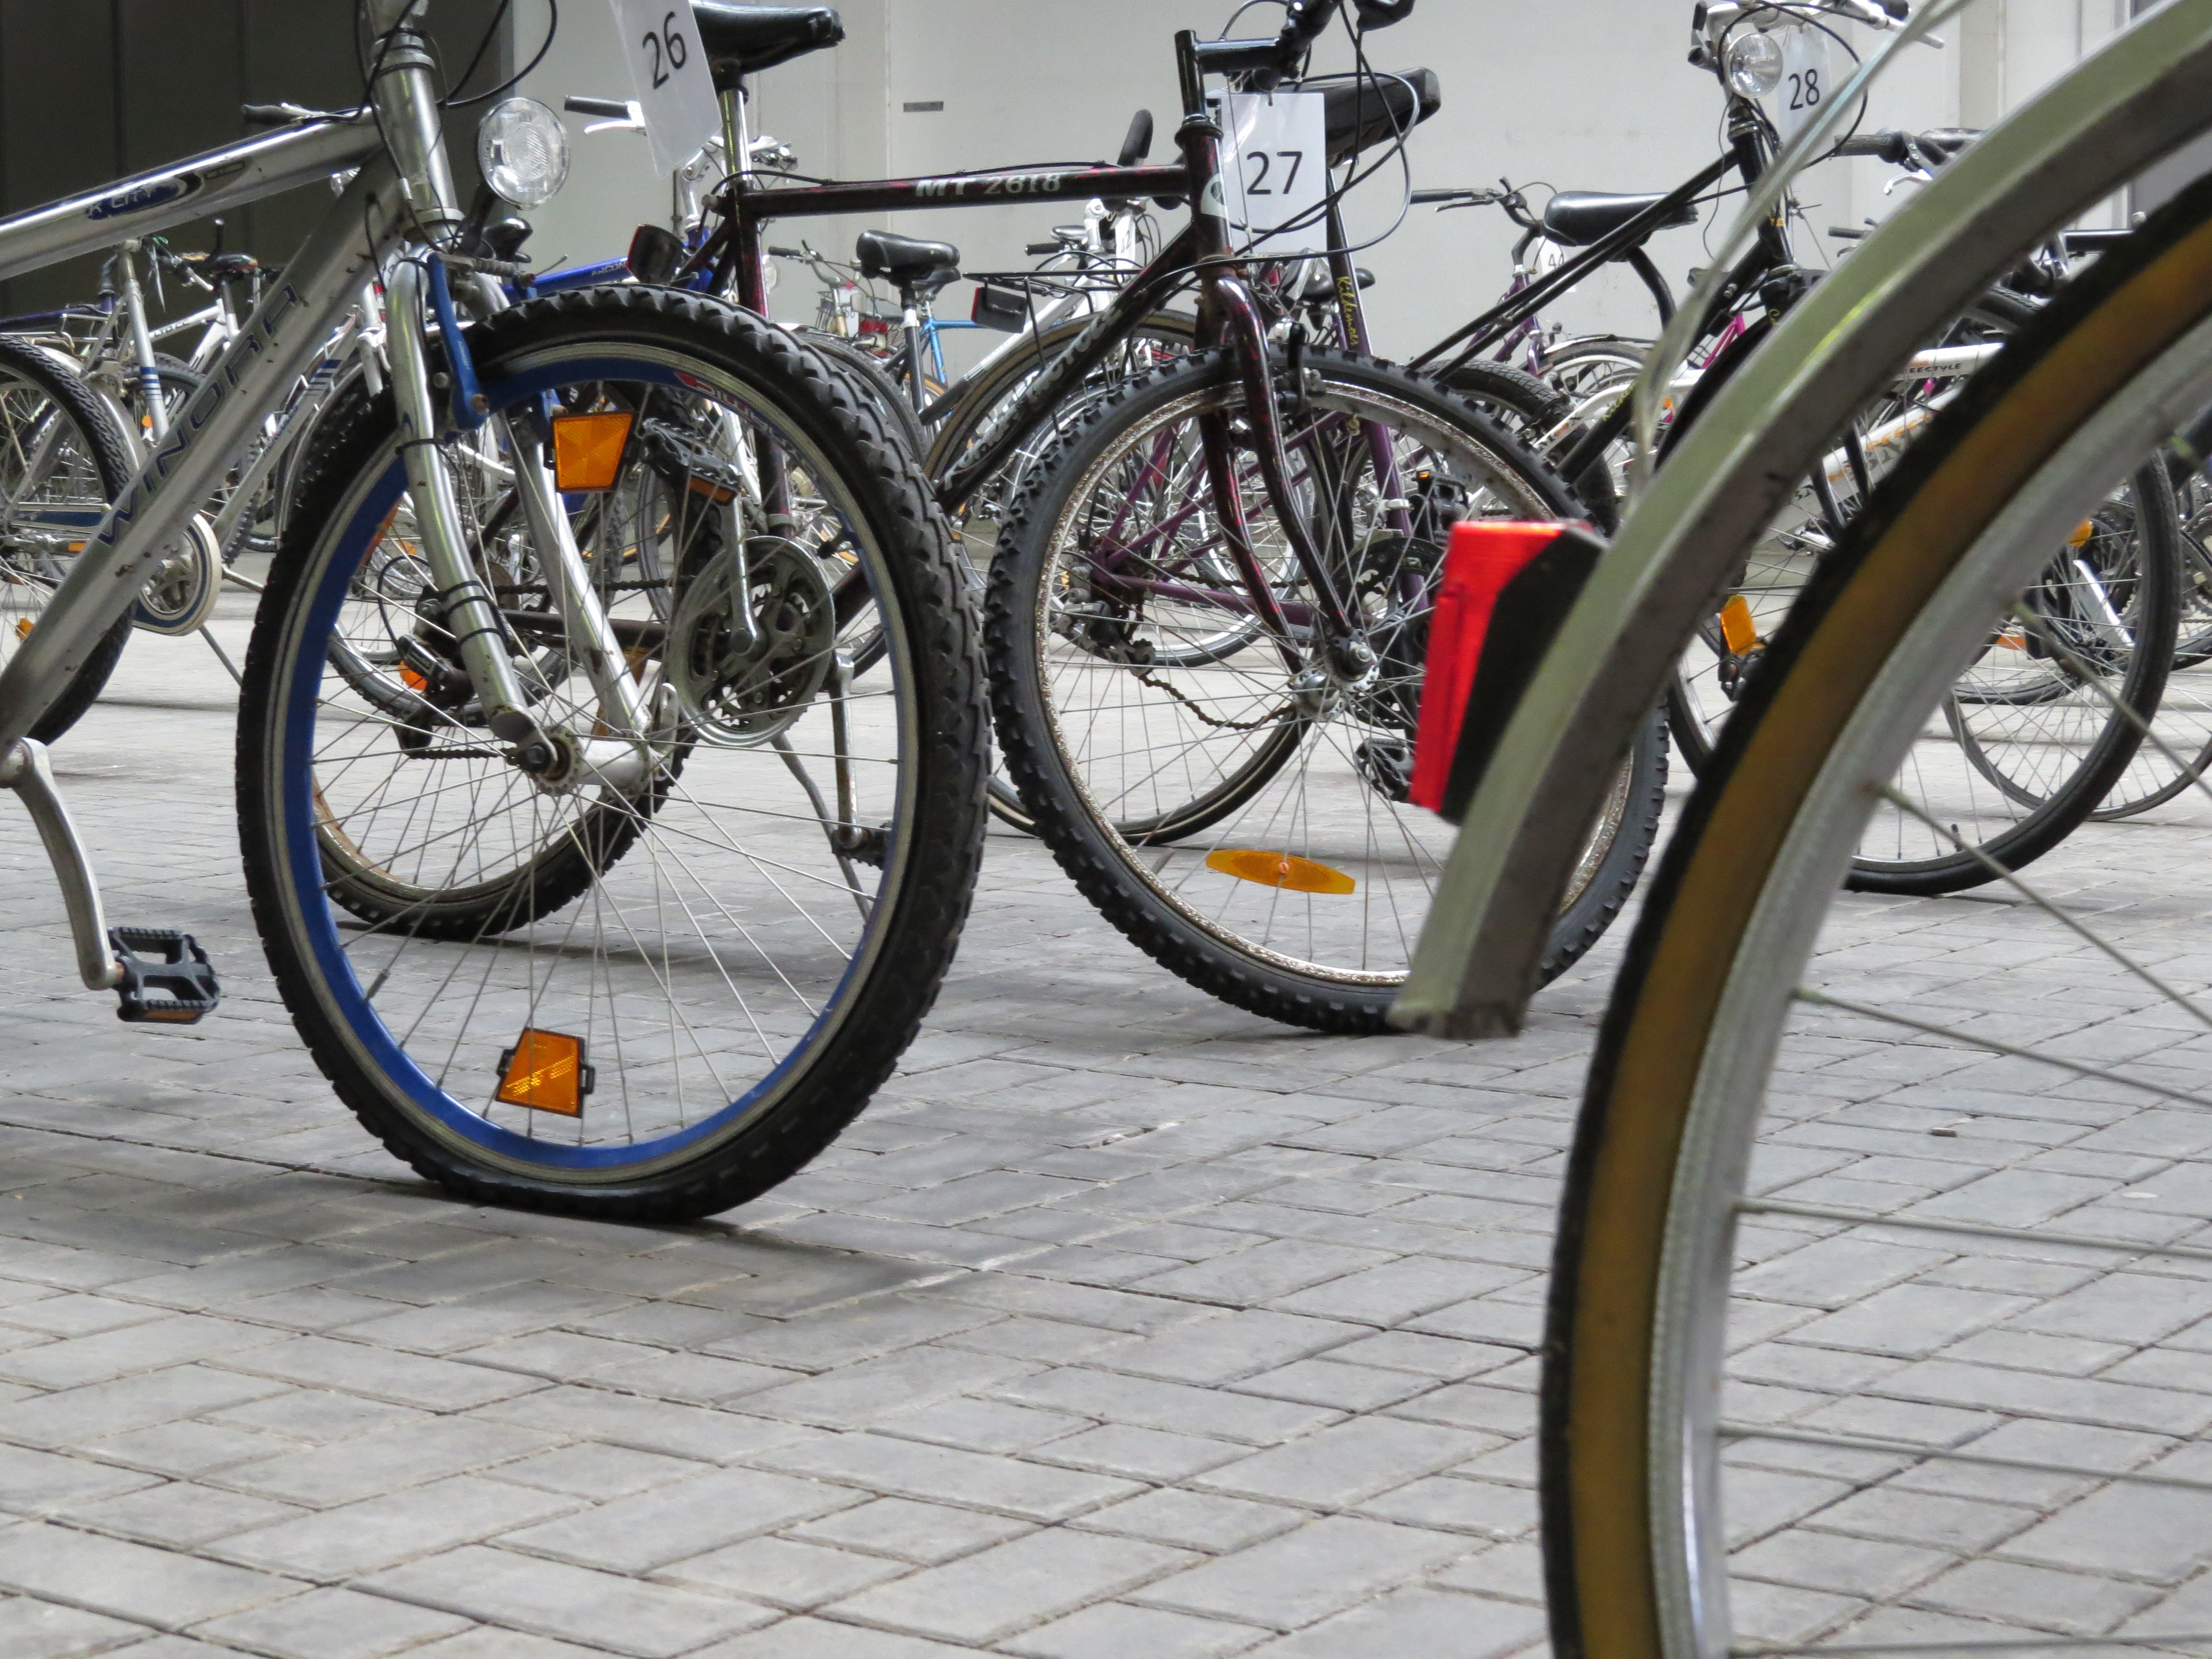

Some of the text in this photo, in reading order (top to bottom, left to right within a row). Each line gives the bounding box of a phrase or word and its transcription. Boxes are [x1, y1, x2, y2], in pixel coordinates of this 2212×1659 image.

[642, 11, 686, 90] 26
[1788, 69, 1819, 110] 28
[915, 172, 1061, 197] MT 2618
[1246, 151, 1302, 195] 27
[96, 282, 299, 545] WINORA
